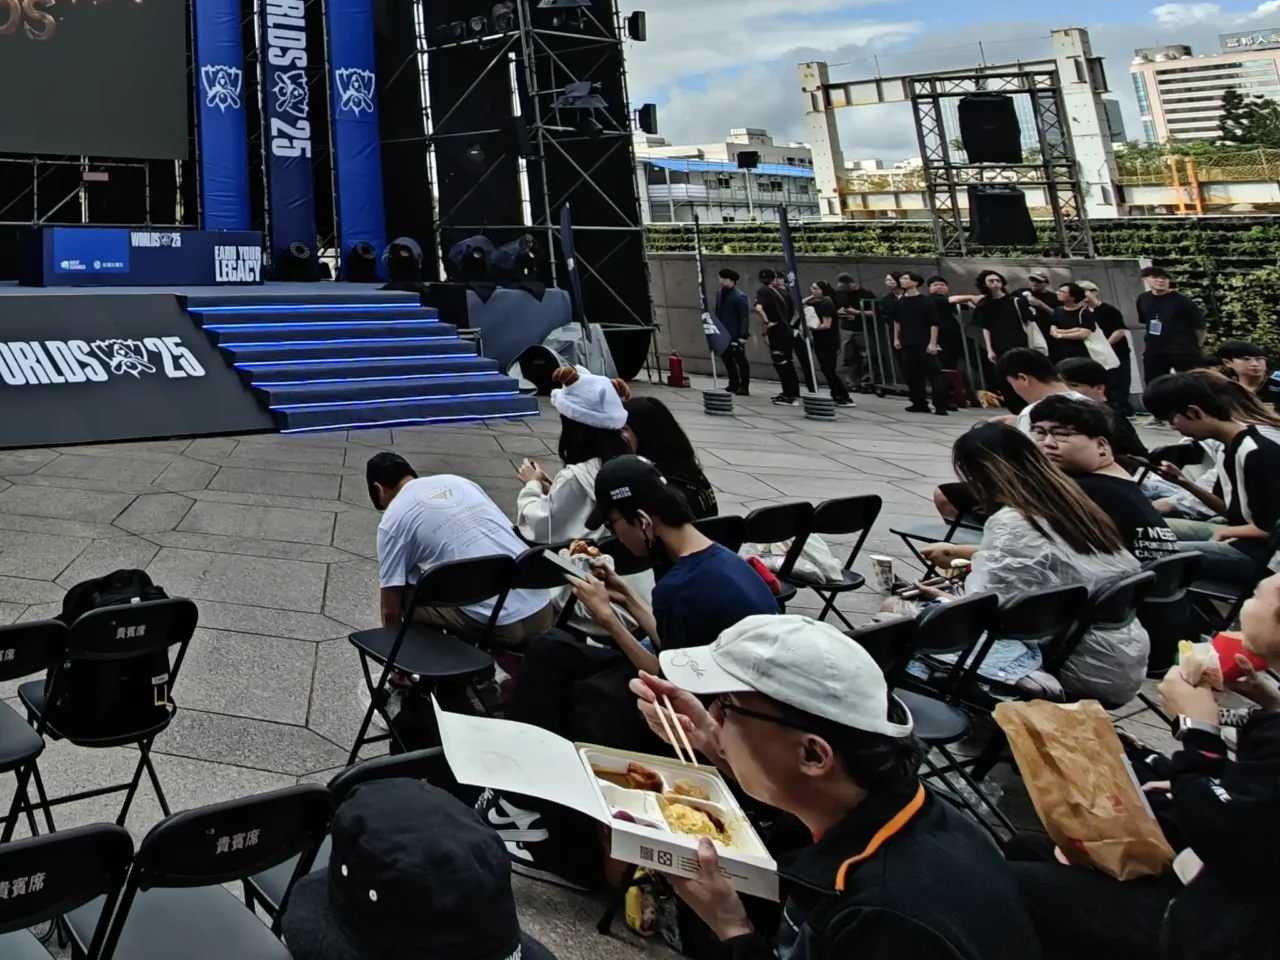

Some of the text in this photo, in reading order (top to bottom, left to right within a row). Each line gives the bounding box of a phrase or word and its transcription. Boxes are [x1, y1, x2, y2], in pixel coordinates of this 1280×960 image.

[270, 117, 312, 158] 25
[131, 232, 181, 247] WORLDS 25
[214, 245, 262, 260] EARN YOUR
[215, 260, 262, 282] LEGACY
[142, 336, 206, 378] 25
[215, 828, 260, 855] 貴賓席
